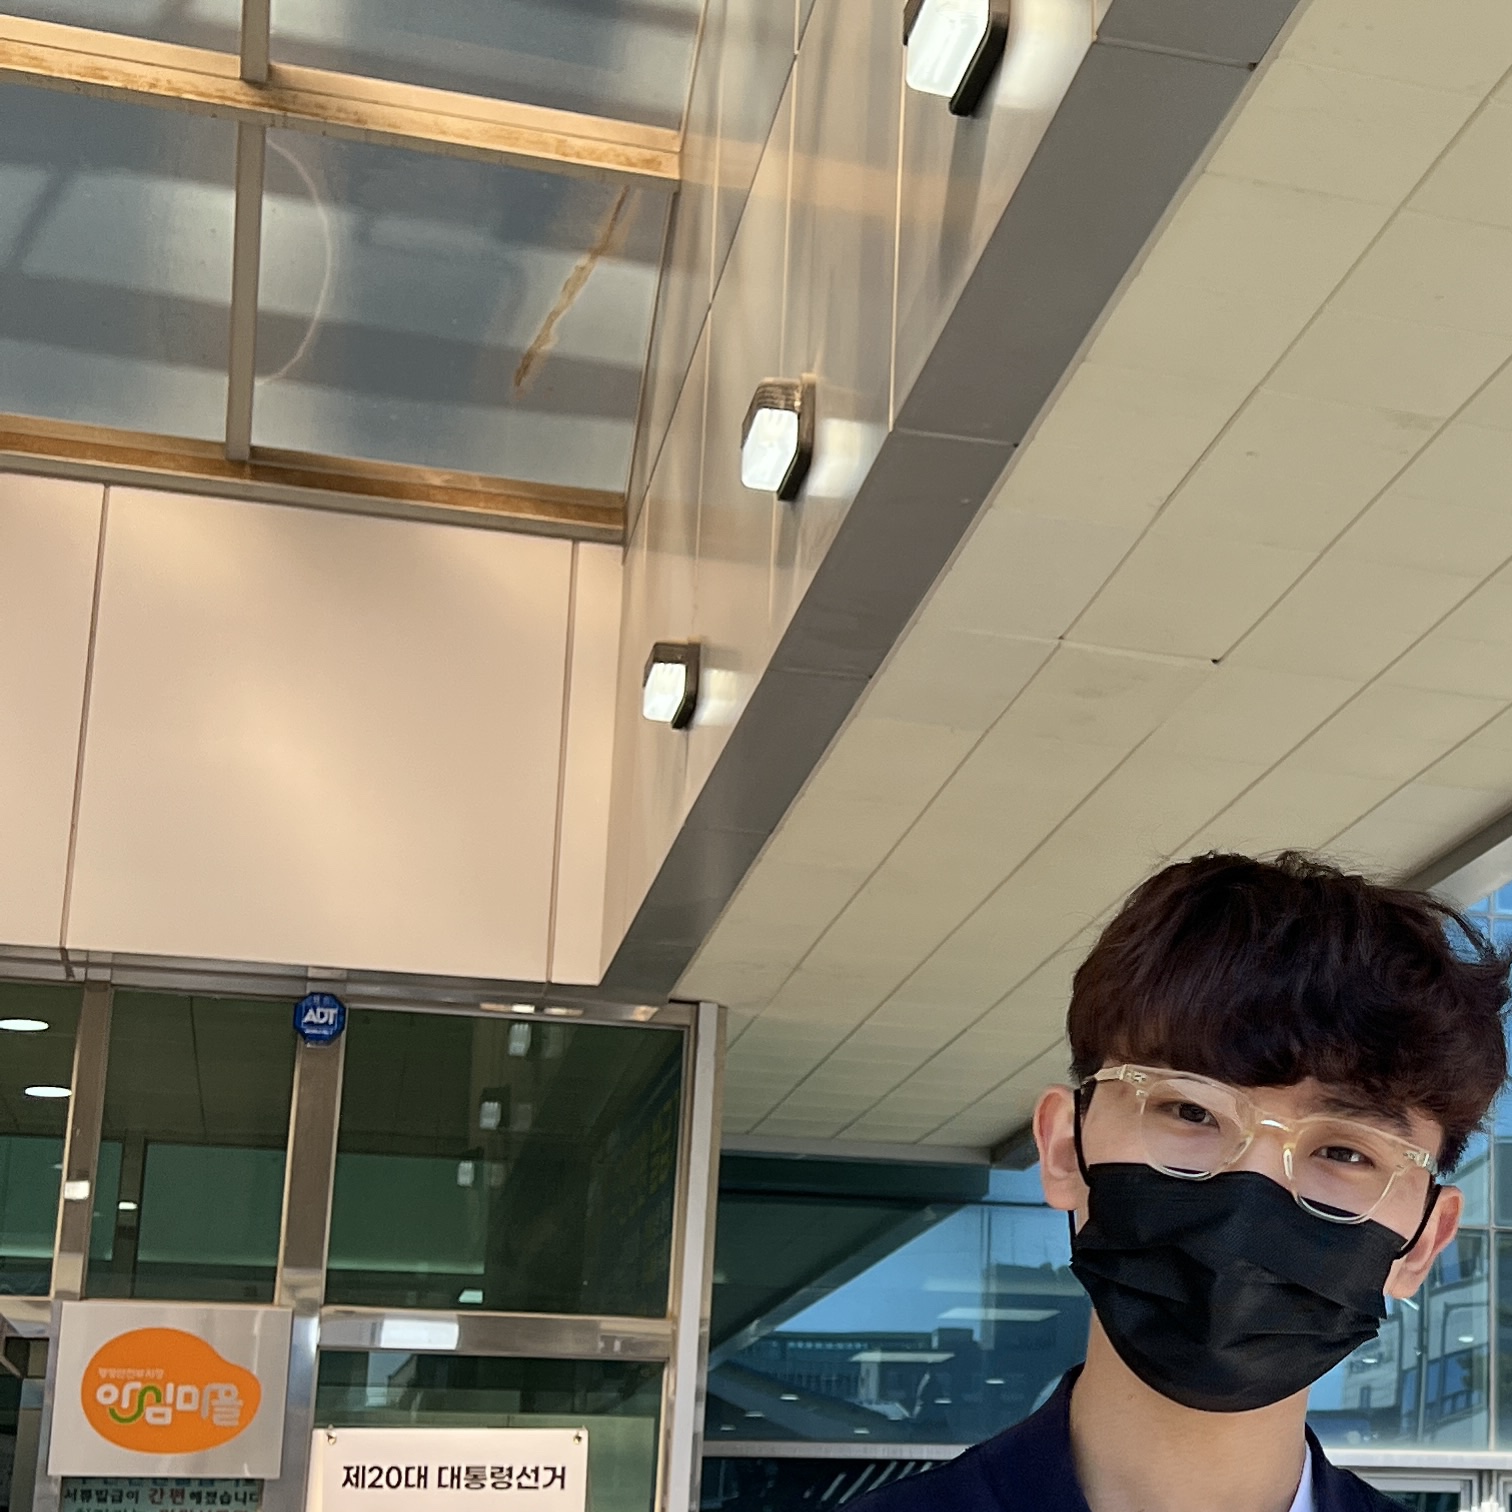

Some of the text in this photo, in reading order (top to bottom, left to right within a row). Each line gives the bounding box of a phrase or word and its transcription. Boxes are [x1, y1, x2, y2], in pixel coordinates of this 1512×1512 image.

[302, 1007, 338, 1025] ADT
[341, 1465, 566, 1490] 제20대 대통령선거
